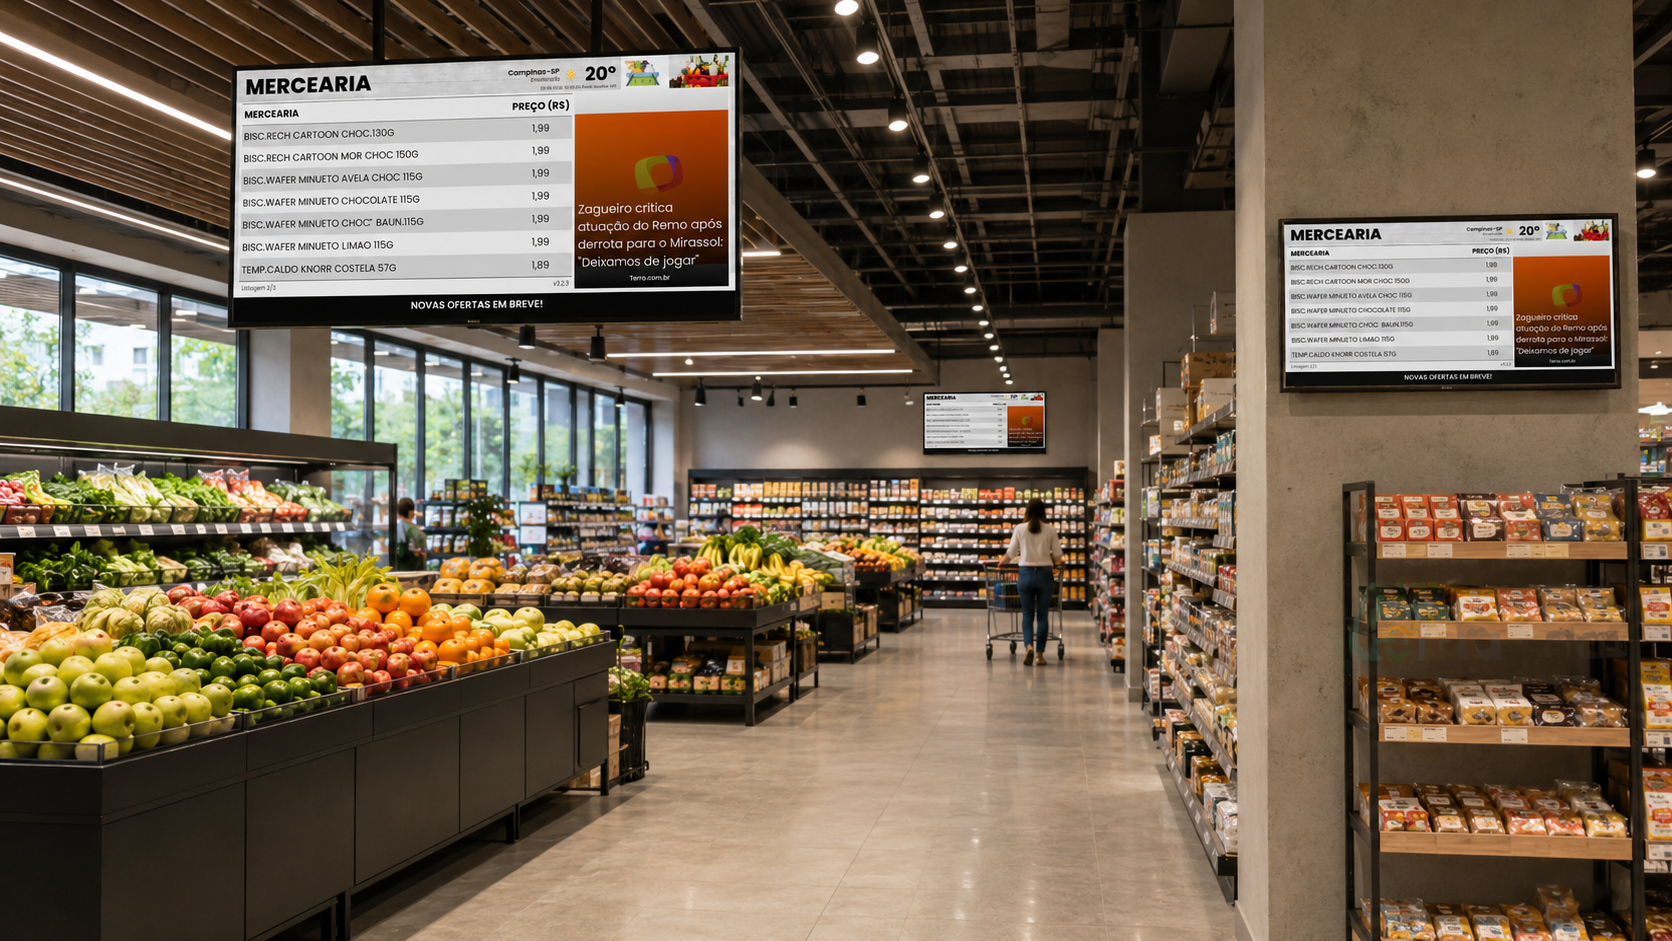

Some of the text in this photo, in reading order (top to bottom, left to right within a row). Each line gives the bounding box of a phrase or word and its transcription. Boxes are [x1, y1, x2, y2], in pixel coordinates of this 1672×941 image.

[246, 75, 371, 95] MERCEARIA
[512, 102, 546, 113] PREÇO
[245, 109, 299, 119] MERCEARIA
[532, 123, 549, 133] 1,99
[244, 129, 394, 141] BISC.RECH CARTOON CHOC.130G
[244, 150, 419, 163] BISC.RECH CARTOON MOR CHOC 150G
[532, 146, 549, 156] 1,99
[243, 172, 423, 185] BISC.WAFER MINUETO AVELA CHOC 115G
[532, 168, 549, 178] 1,99
[243, 195, 420, 207] BISC.WAFER MINUETO CHOCOLATE 115G
[532, 191, 549, 201] 1,99
[578, 203, 632, 217] Zagueiro
[243, 220, 296, 229] BISC.WAFER
[298, 219, 339, 228] MINUETO
[376, 217, 424, 226] BAUN.115G
[532, 214, 549, 224] 1,99
[578, 218, 722, 234] atuação do Remo após
[1291, 228, 1382, 241] MERCEARIA
[242, 240, 394, 252] BISC.WAFER MINUETO LIMAO 115G
[532, 237, 549, 247] 1,99
[578, 236, 723, 252] derrota para o Mirassol:
[532, 260, 549, 270] 1,89
[578, 254, 699, 269] "Deixamos de jogar"
[242, 263, 396, 274] TEMP.CALDO KNORR COSTELA 57G
[411, 300, 543, 309] NOVAS OFERTAS EM BREVE!
[1547, 337, 1566, 345] para
